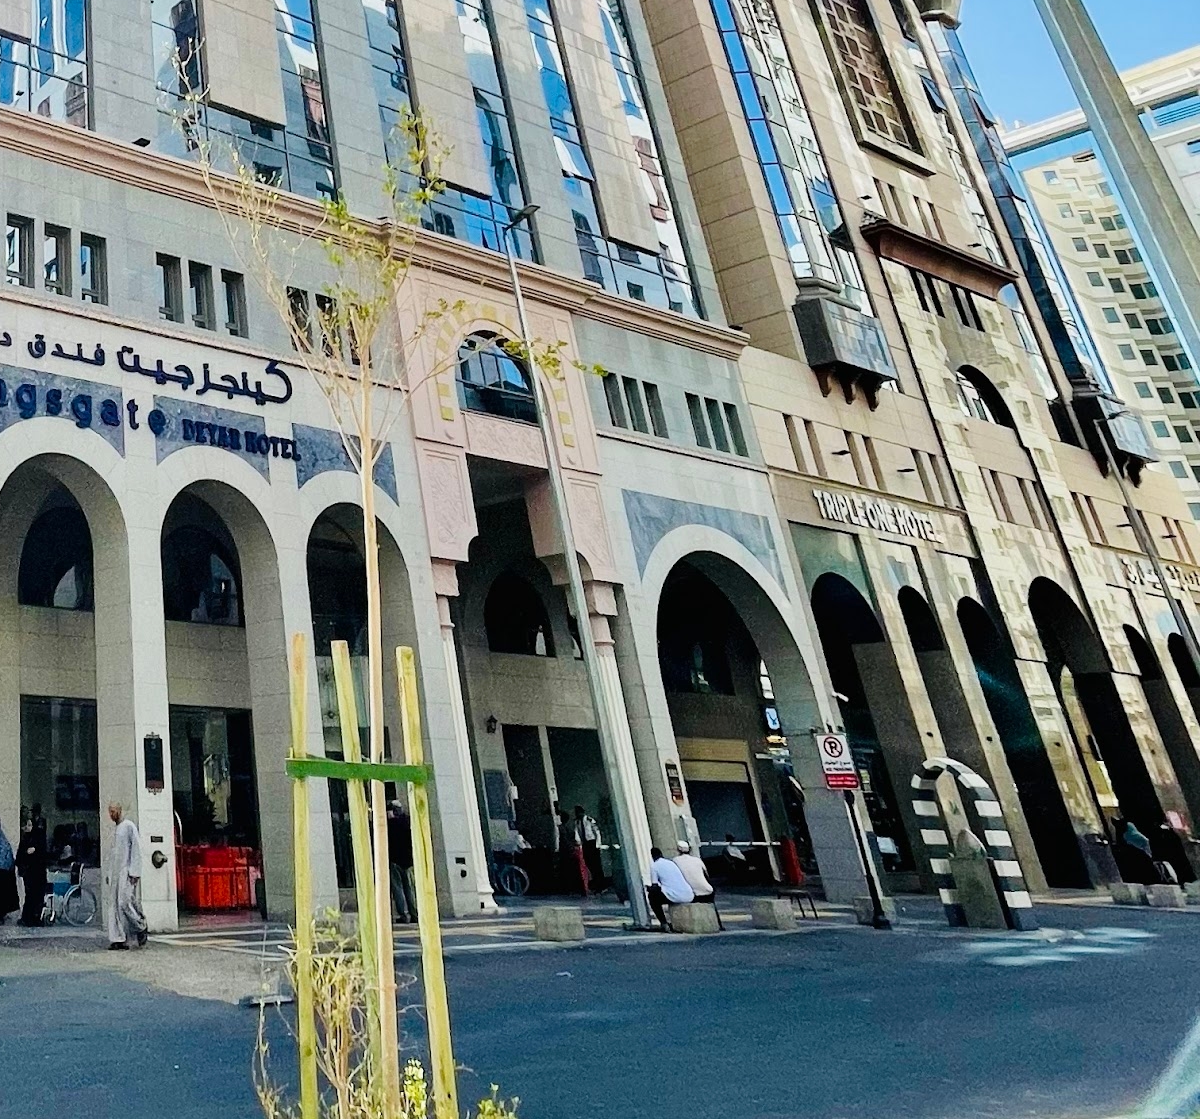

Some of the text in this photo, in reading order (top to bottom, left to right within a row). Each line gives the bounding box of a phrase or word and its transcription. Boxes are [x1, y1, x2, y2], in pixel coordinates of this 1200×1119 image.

[28, 334, 106, 366] فندق
[182, 419, 241, 450] DEYAR
[244, 431, 302, 461] HOTEL
[812, 489, 944, 543] TRIPLE ONE HOTEL
